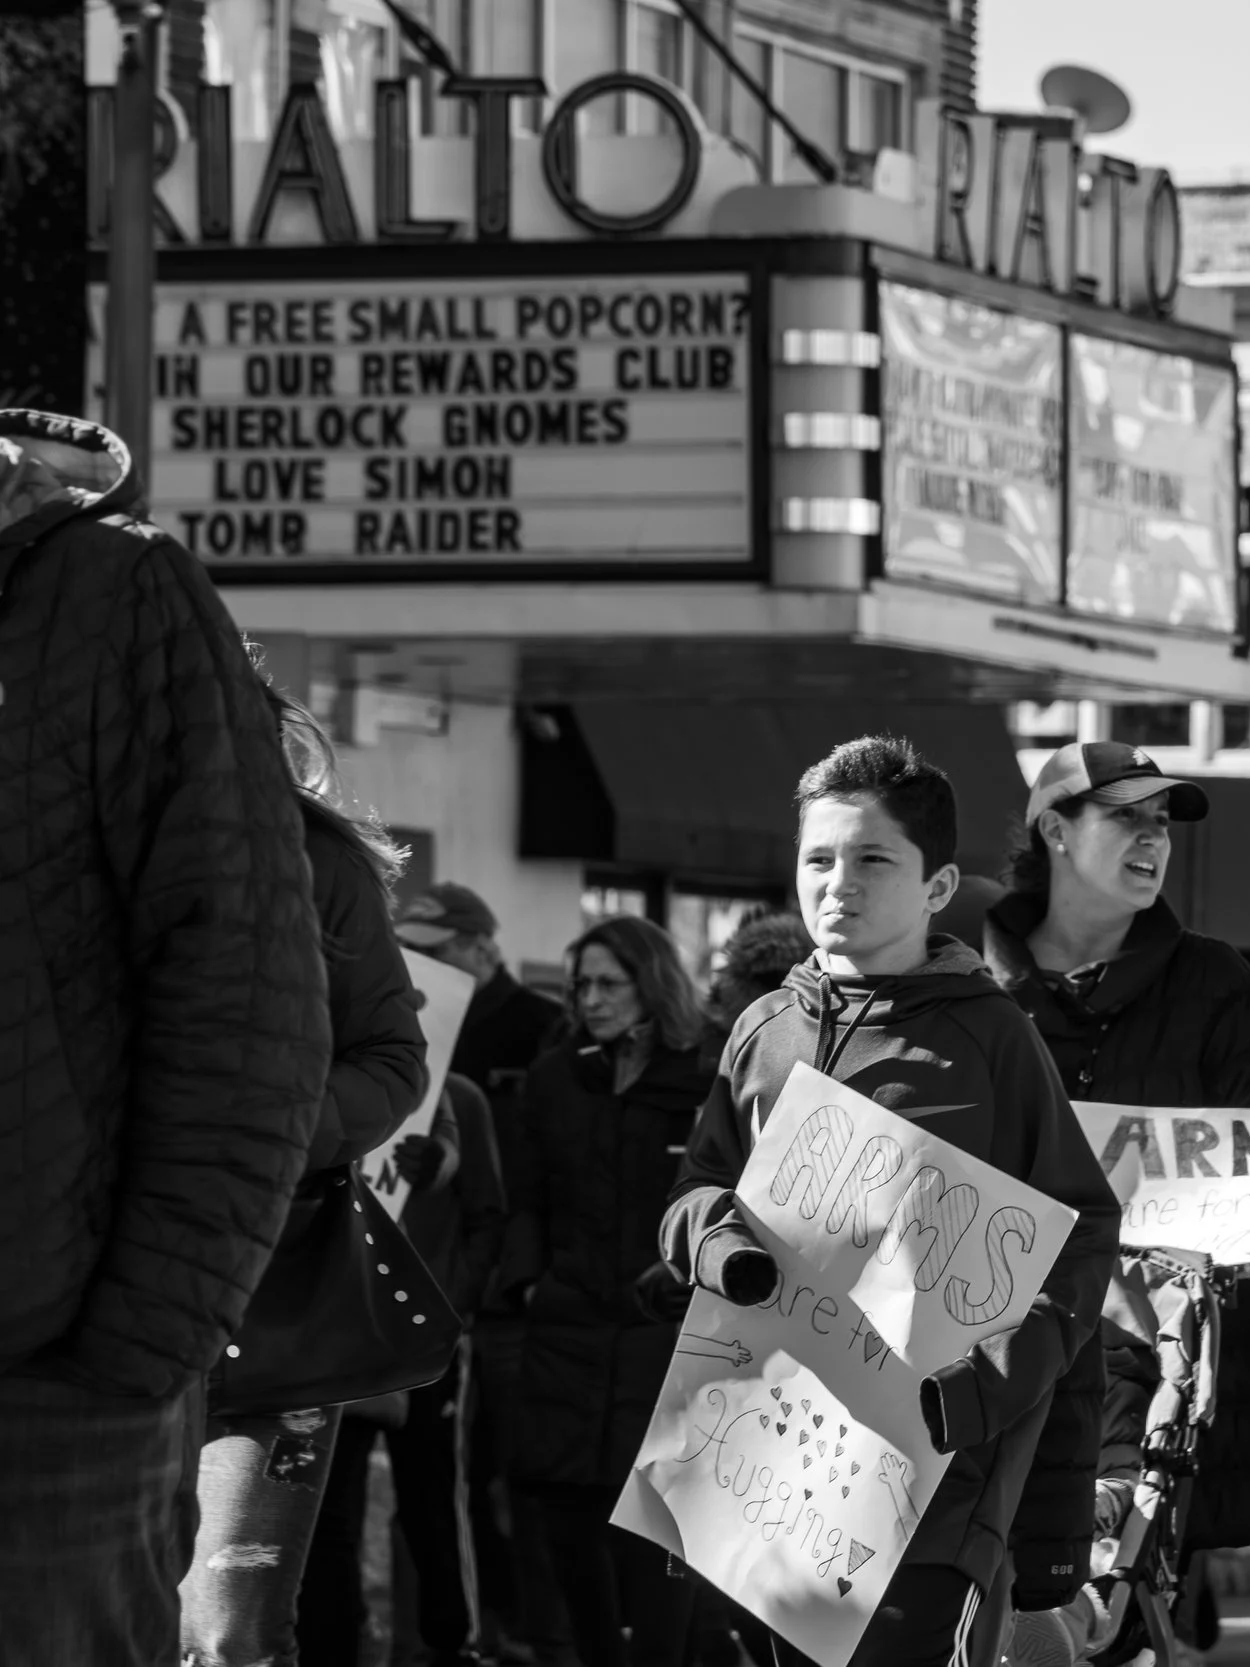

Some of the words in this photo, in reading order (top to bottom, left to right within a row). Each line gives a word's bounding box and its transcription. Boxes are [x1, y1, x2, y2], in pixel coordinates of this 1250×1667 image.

[88, 72, 700, 244] RIALTO
[934, 110, 1180, 320] RIALTO
[180, 300, 205, 345] A
[228, 299, 336, 345] FREE
[348, 297, 497, 344] SMALL
[516, 290, 751, 340] POPCORN?
[246, 353, 334, 398] OUR
[360, 348, 578, 396] REWARDS
[616, 344, 735, 391] CLUB
[171, 405, 408, 450] SHERLOCK
[444, 398, 630, 449] GNOMES
[215, 457, 326, 502] LOVE
[356, 506, 522, 556] RAIDER
[770, 1105, 1036, 1326] ARMS
[674, 1388, 844, 1577] Hugging
